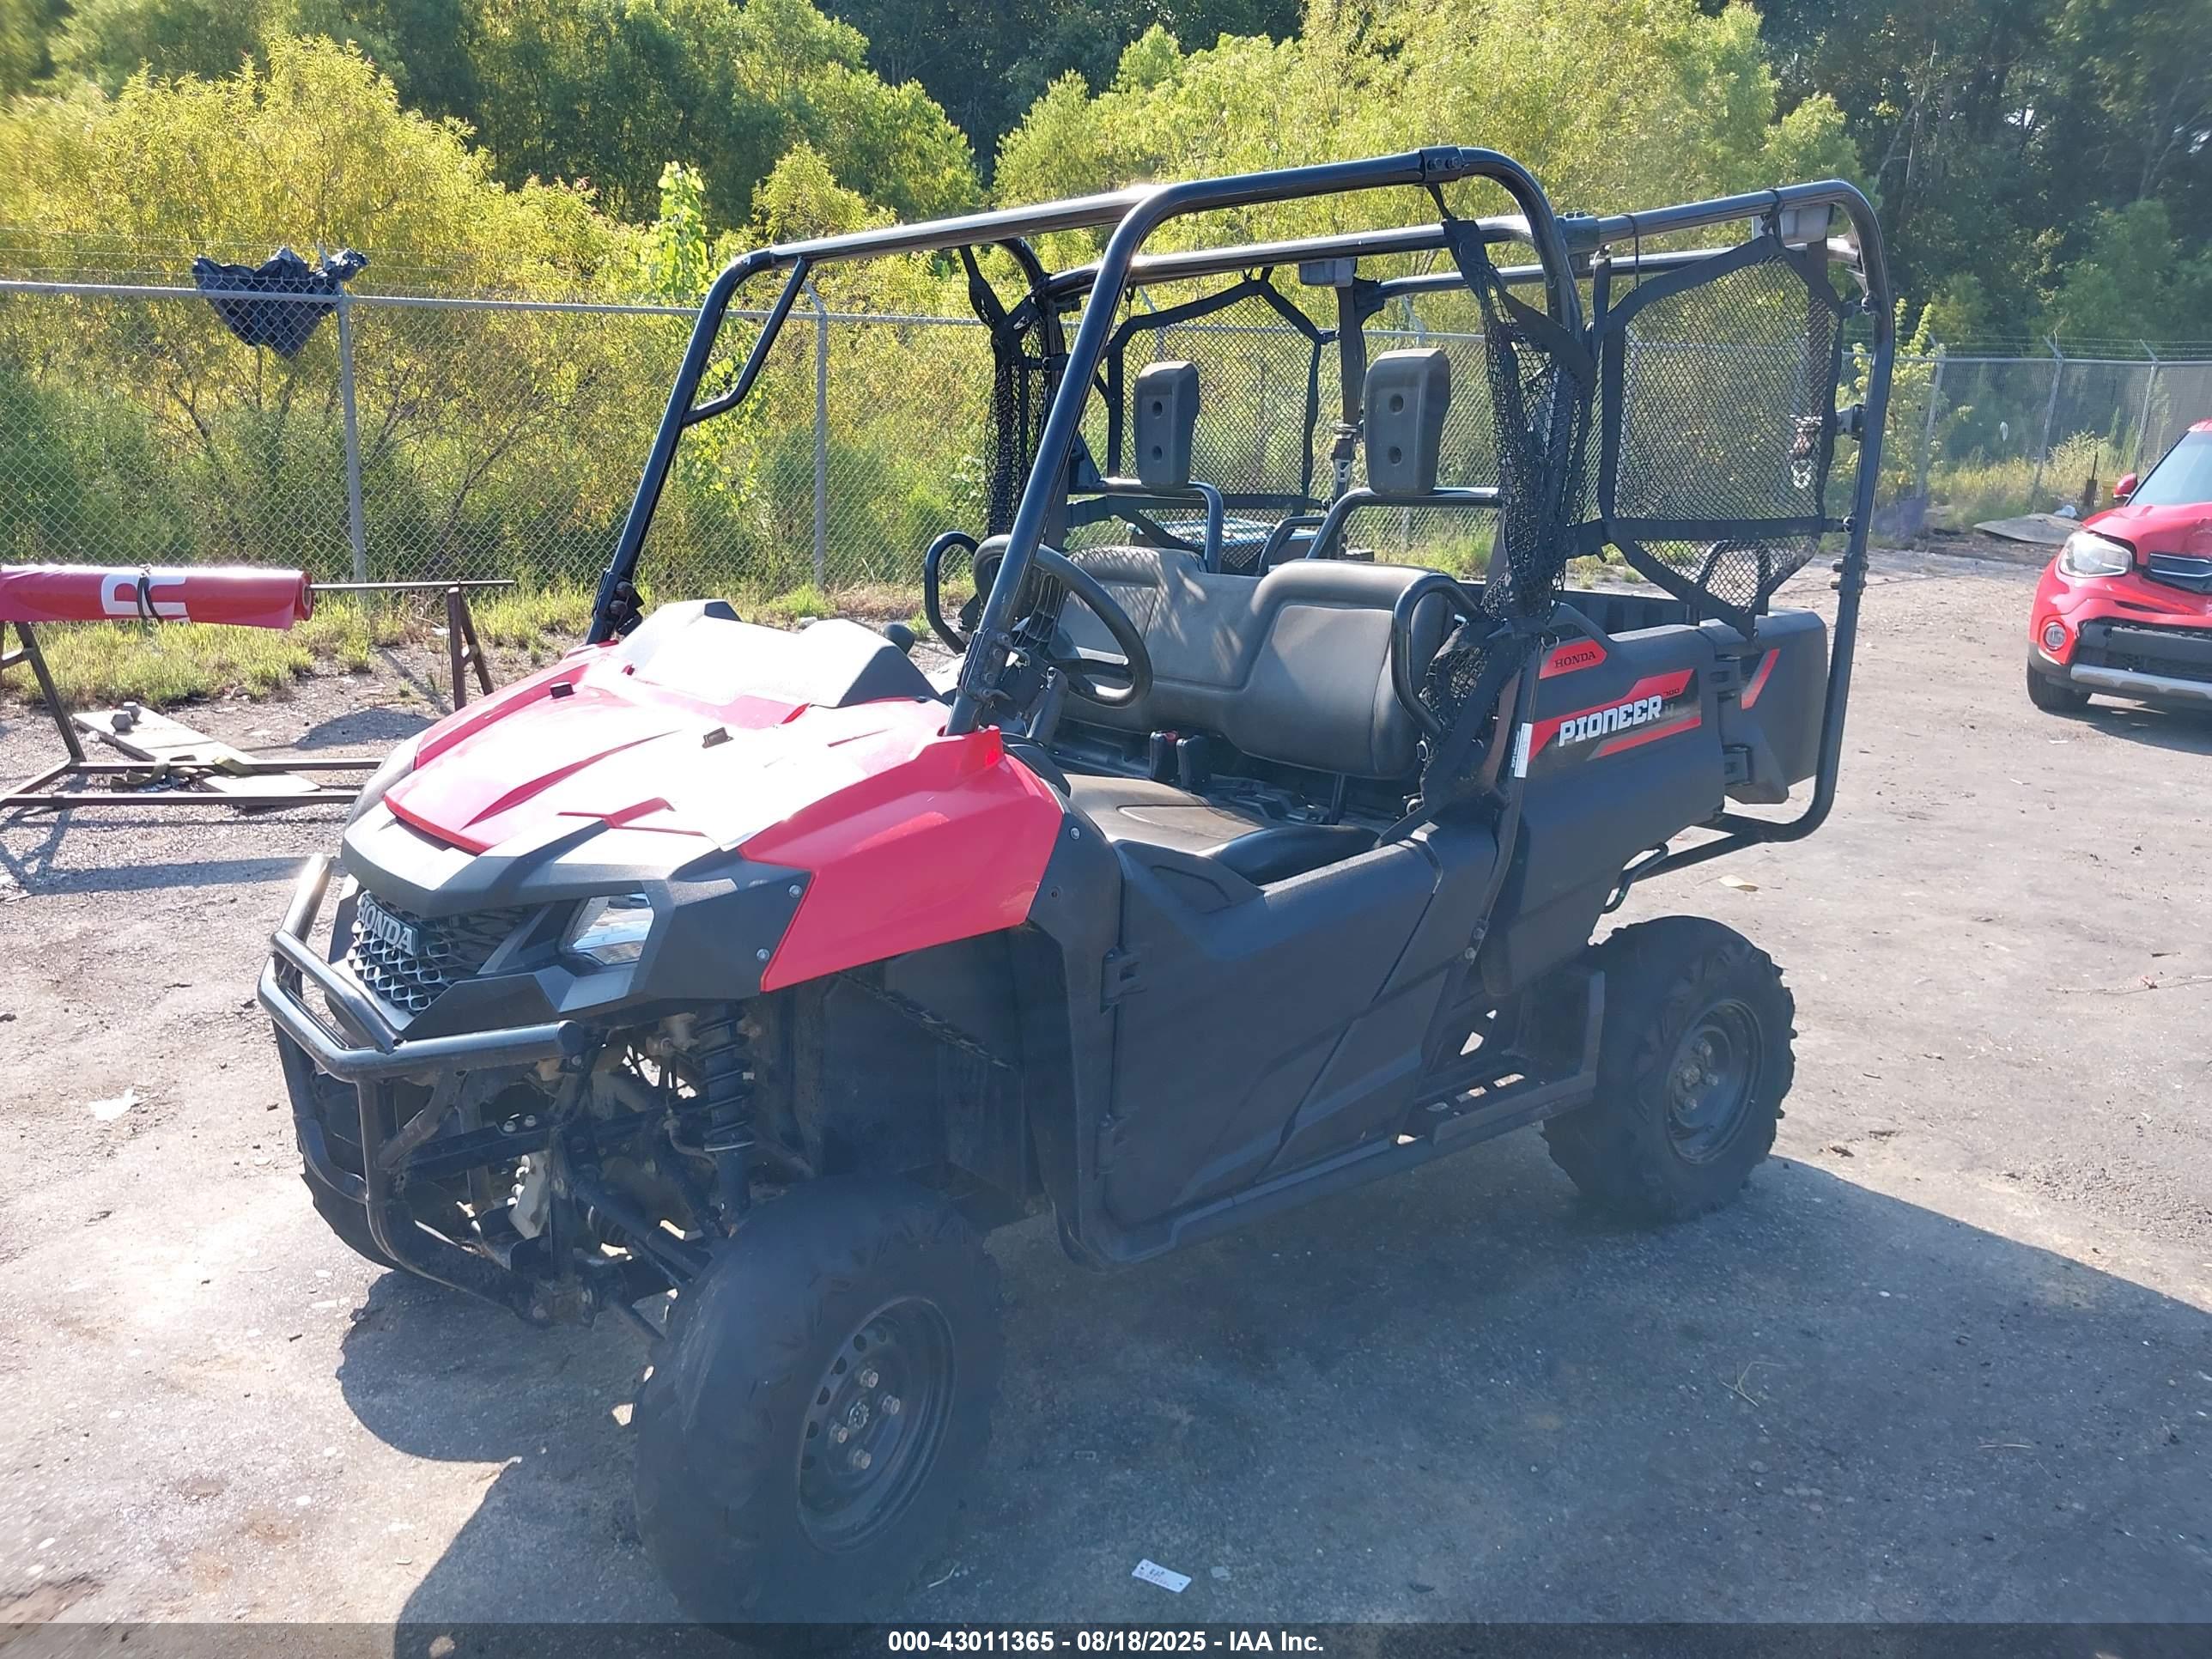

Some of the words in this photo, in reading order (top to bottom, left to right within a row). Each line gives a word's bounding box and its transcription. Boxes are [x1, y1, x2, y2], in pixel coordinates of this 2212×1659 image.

[1554, 651, 1596, 668] HONDA
[1558, 695, 1663, 747] PIONEER
[356, 901, 414, 956] HONDA
